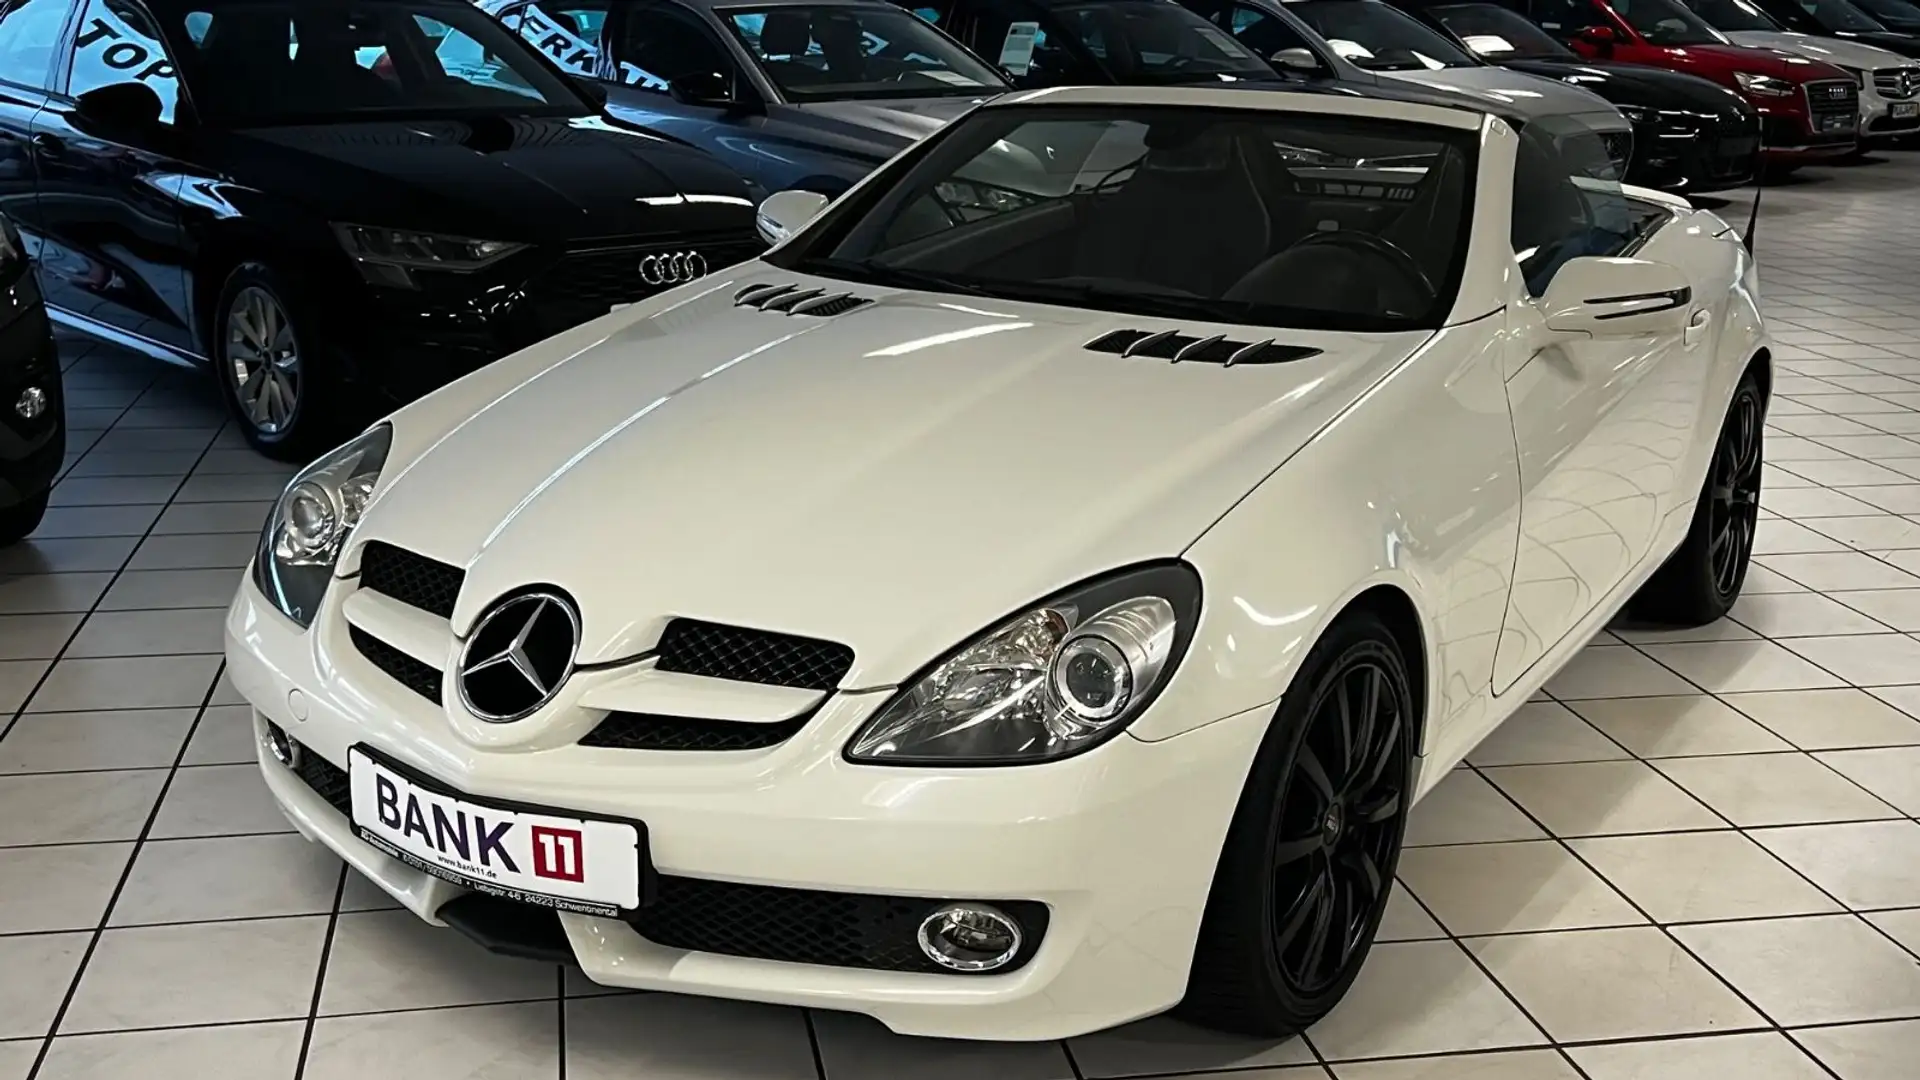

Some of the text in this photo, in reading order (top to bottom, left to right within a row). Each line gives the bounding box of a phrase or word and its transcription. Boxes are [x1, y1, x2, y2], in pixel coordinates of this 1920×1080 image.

[77, 18, 177, 81] TOP
[376, 773, 521, 874] BANK
[537, 832, 579, 877] 11
[437, 855, 498, 879] www.bank11.de
[524, 893, 554, 908] 24223
[555, 899, 618, 917] Schwentinental
